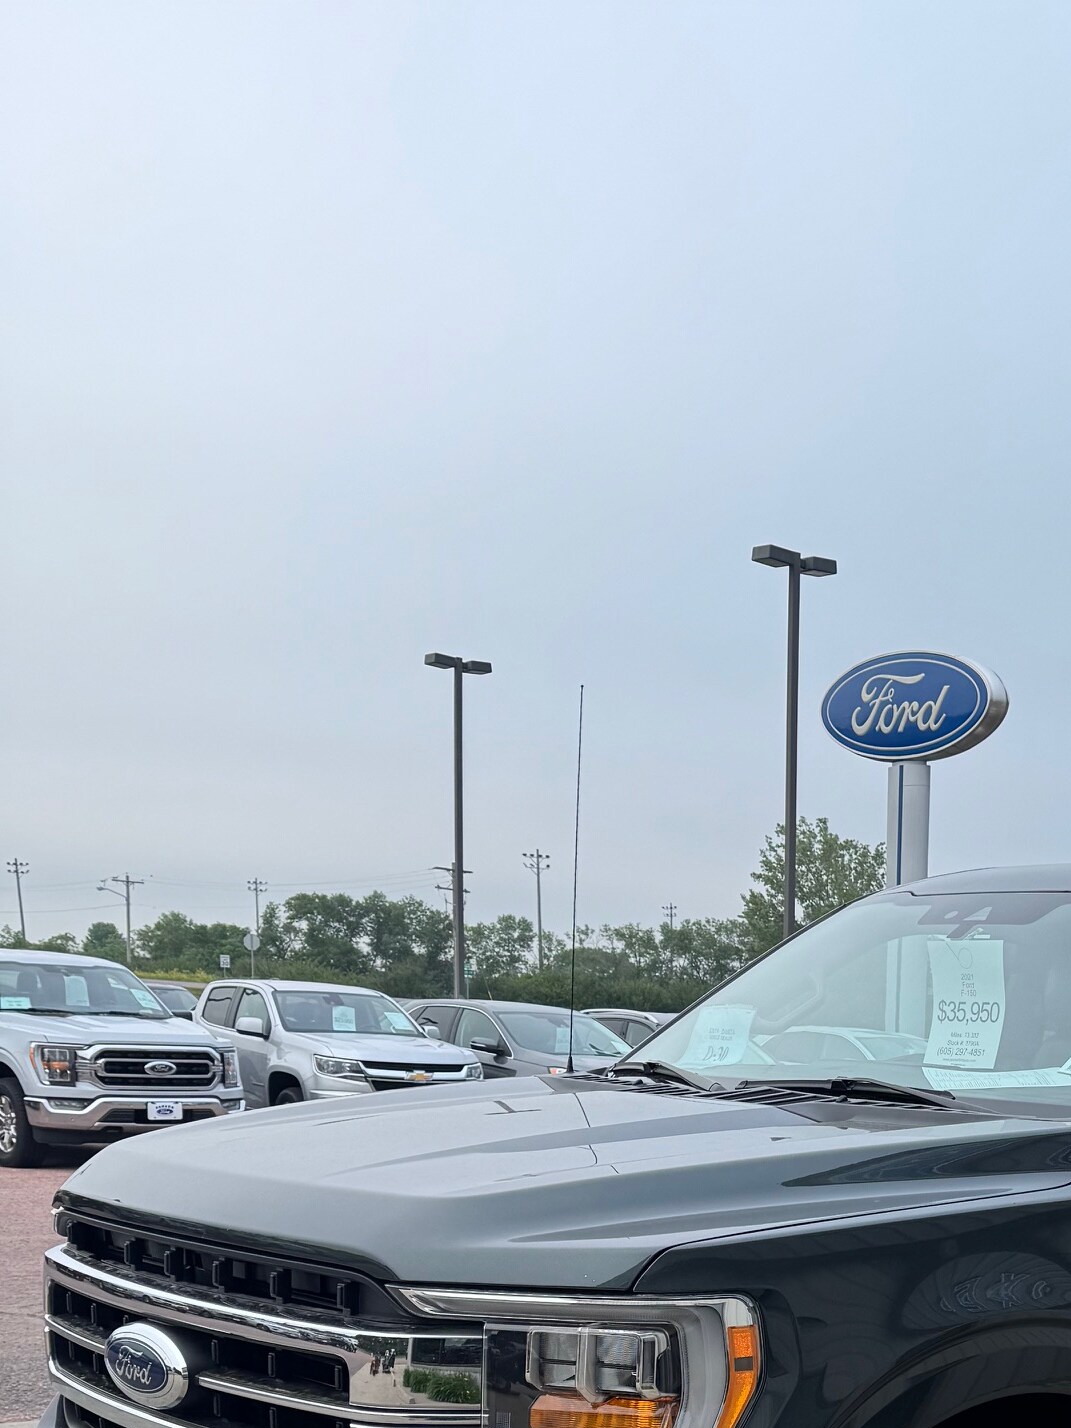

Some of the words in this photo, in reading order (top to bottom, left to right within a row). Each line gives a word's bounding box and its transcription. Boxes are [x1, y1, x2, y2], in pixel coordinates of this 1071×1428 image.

[851, 673, 950, 736] Ford
[960, 989, 977, 997] F-150
[962, 981, 975, 989] Ford
[937, 1000, 1000, 1026] $35,950
[936, 1046, 954, 1056] (605)
[955, 1047, 985, 1056] 297-4851
[115, 1345, 153, 1385] Ford
